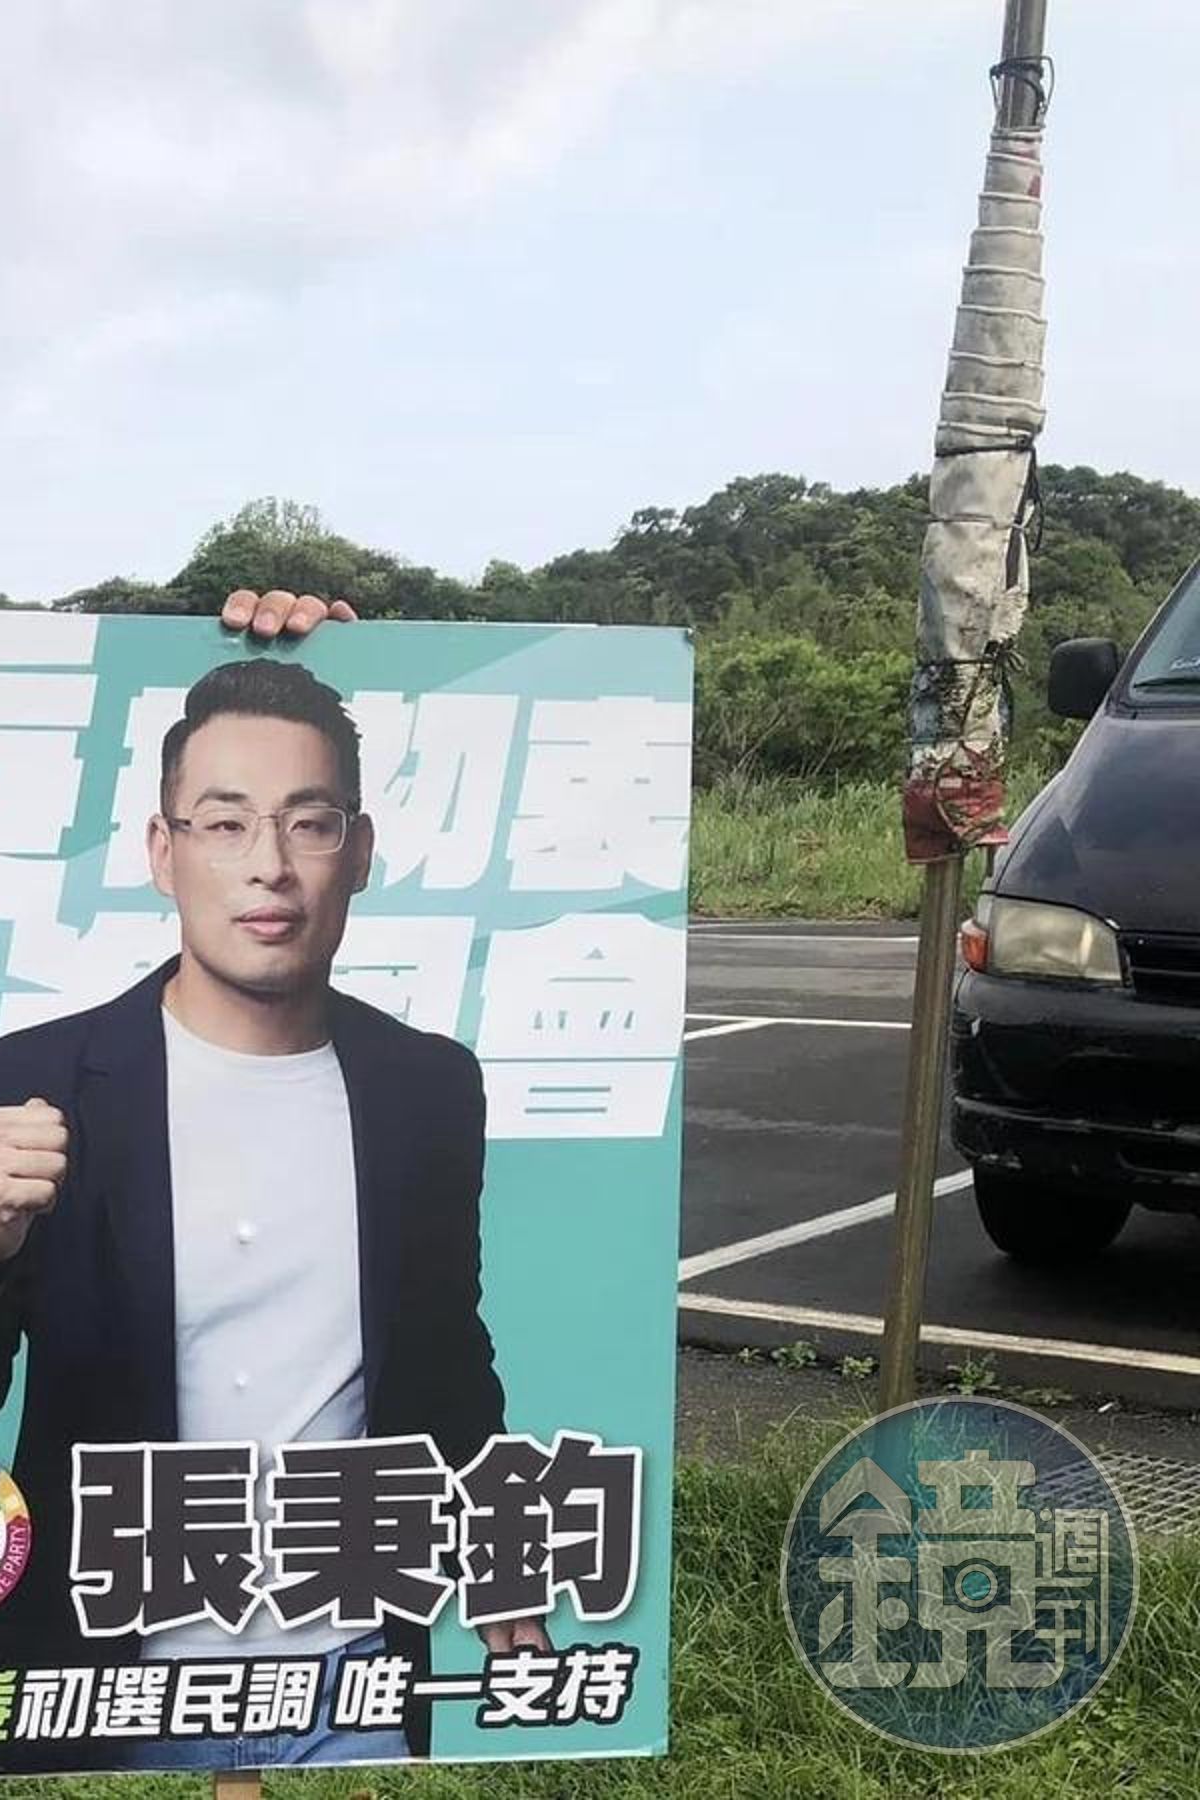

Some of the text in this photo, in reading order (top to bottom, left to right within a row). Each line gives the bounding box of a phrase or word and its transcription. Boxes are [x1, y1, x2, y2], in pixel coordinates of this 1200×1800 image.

[3, 1524, 28, 1577] PARTY
[72, 1433, 640, 1637] 張秉鈞
[334, 1648, 634, 1726] 唯一支持
